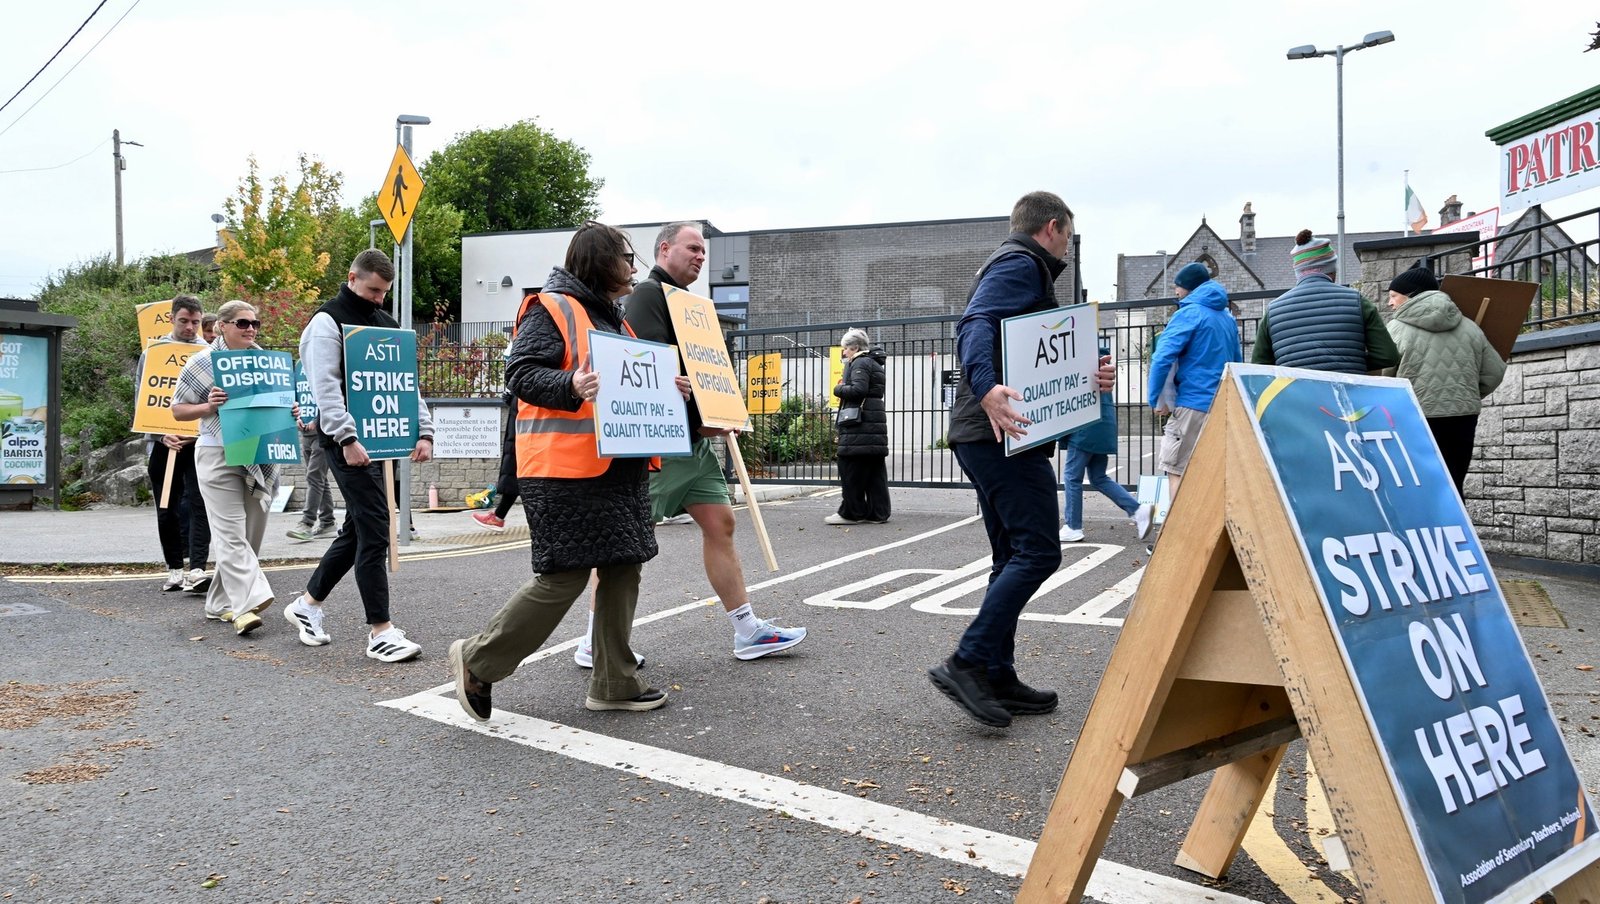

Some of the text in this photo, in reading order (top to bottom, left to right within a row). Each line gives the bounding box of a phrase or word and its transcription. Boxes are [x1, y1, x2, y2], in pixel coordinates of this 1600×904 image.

[1505, 117, 1600, 197] PATR
[154, 311, 172, 325] AS
[685, 307, 711, 331] ASTI
[165, 353, 188, 367] AS
[364, 343, 401, 362] ASTI
[1034, 330, 1076, 369] ASTI
[216, 355, 291, 371] OFFICIAL
[221, 371, 291, 388] DISPUTE
[351, 370, 415, 392] STRIKE
[620, 359, 659, 390] ASTI
[1023, 377, 1063, 403] QUALITY
[1064, 372, 1080, 392] PAY
[372, 394, 399, 415] ON
[611, 400, 648, 416] QUALITY
[650, 403, 665, 417] PAY
[1055, 390, 1098, 417] TEACHERS
[362, 417, 410, 438] HERE
[436, 425, 471, 433] responsible
[455, 433, 479, 441] damage
[603, 422, 685, 438] QUALITY TEACHERS
[8, 436, 39, 449] alpro
[3, 449, 43, 458] BARISTA
[1323, 430, 1422, 492] ASTI
[4, 460, 42, 469] COCONUT
[1321, 525, 1490, 617] STRIKE
[1408, 612, 1488, 700] ON
[1414, 694, 1547, 814] HERE
[1460, 806, 1582, 888] Association of Secondary Teachers, Ireland
